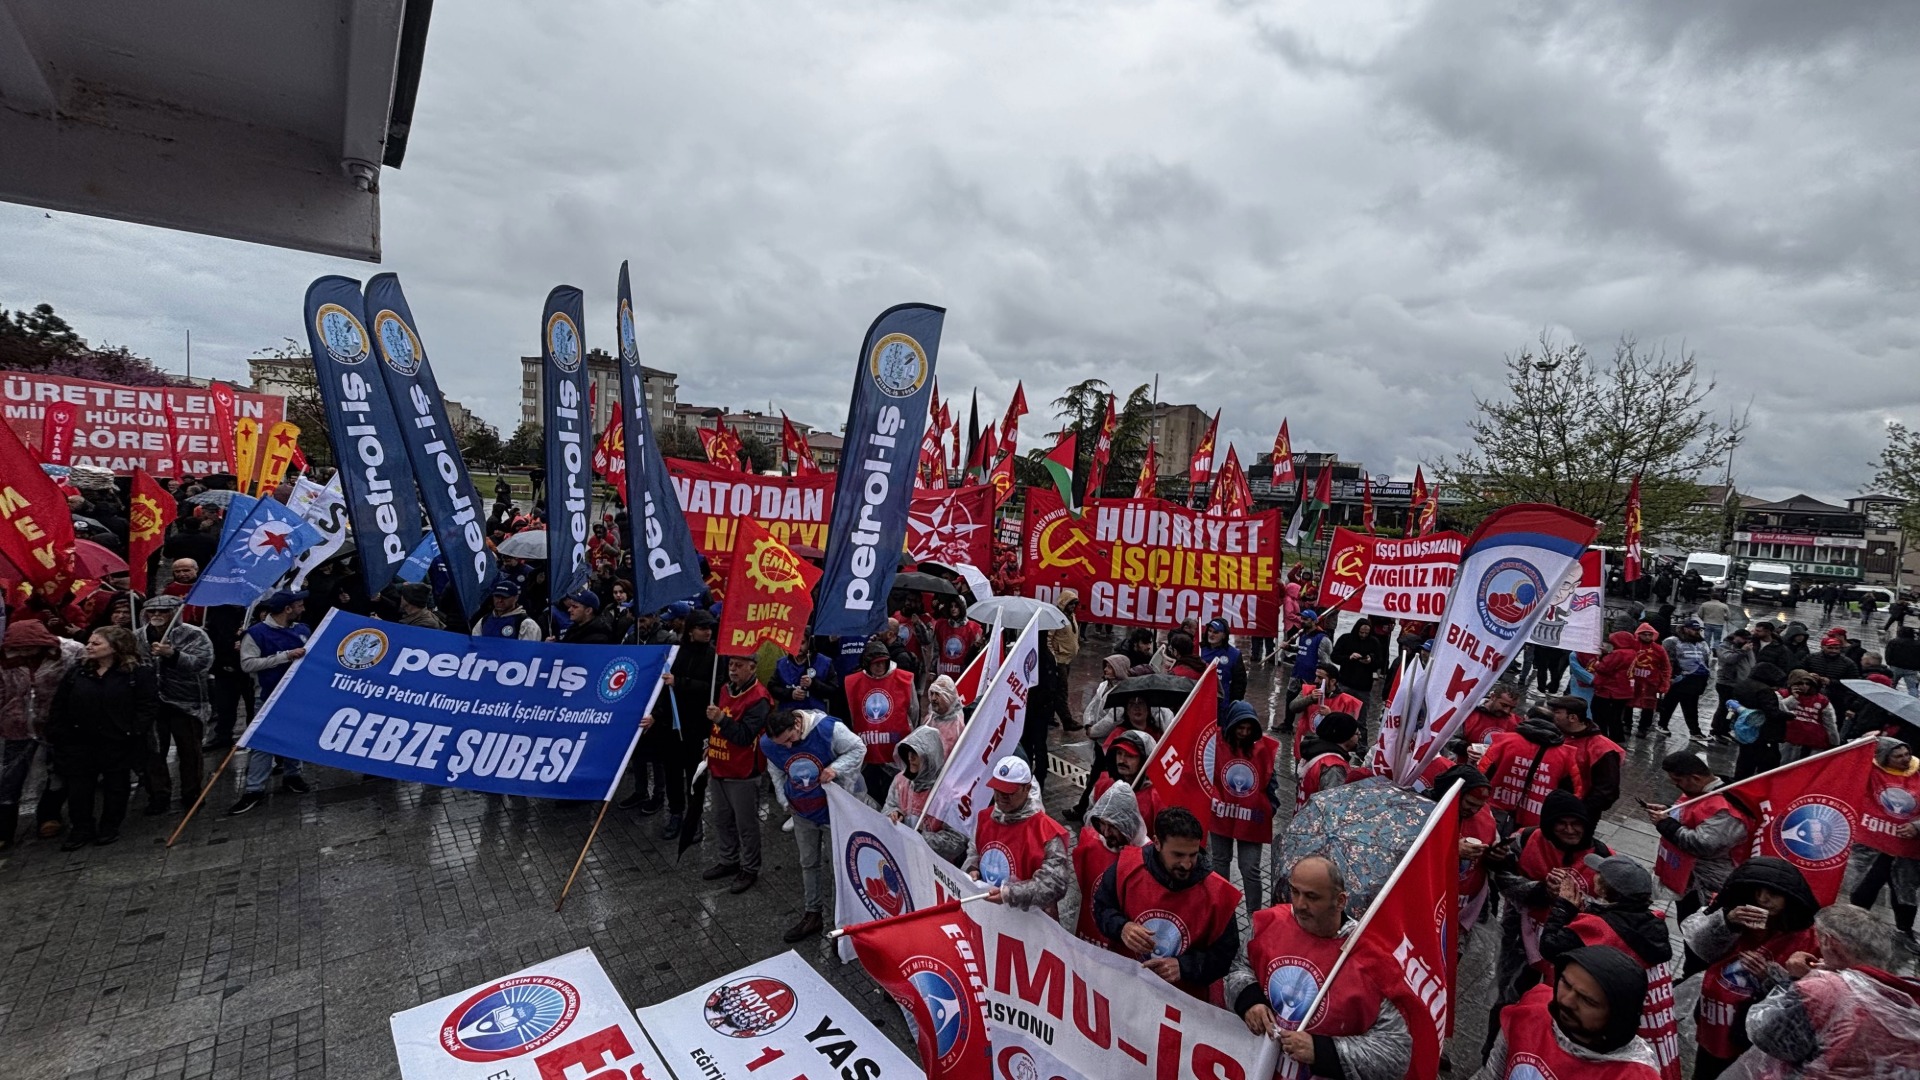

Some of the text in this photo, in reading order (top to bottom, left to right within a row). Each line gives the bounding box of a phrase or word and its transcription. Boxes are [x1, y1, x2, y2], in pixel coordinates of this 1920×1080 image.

[342, 372, 406, 565] petrol-iş
[845, 405, 906, 612] petrol-iş
[1095, 502, 1264, 554] HÜRRİYET
[1375, 539, 1401, 560] İŞÇİ
[1111, 539, 1274, 592] İŞÇİLERLE
[1369, 565, 1428, 587] İNGİLİZ
[746, 602, 793, 622] EMEK
[1090, 581, 1258, 630] GELECEK!
[1383, 592, 1412, 613] GO
[389, 646, 588, 697] petrol-iş
[331, 673, 614, 725] Türkiye Petrol Kimya Lastik İşçileri Sendikası
[318, 706, 587, 783] GEBZE ŞUBESİ
[709, 735, 728, 750] MEK
[1514, 755, 1550, 773] EMK
[1211, 797, 1252, 821] Eğitim
[499, 977, 530, 988] EĞİTİM
[544, 978, 563, 989] BİLİM
[765, 989, 786, 1001] 1
[739, 984, 778, 1021] MAYIS
[525, 1020, 568, 1051] SENDİKASI
[745, 1045, 786, 1073] 1
